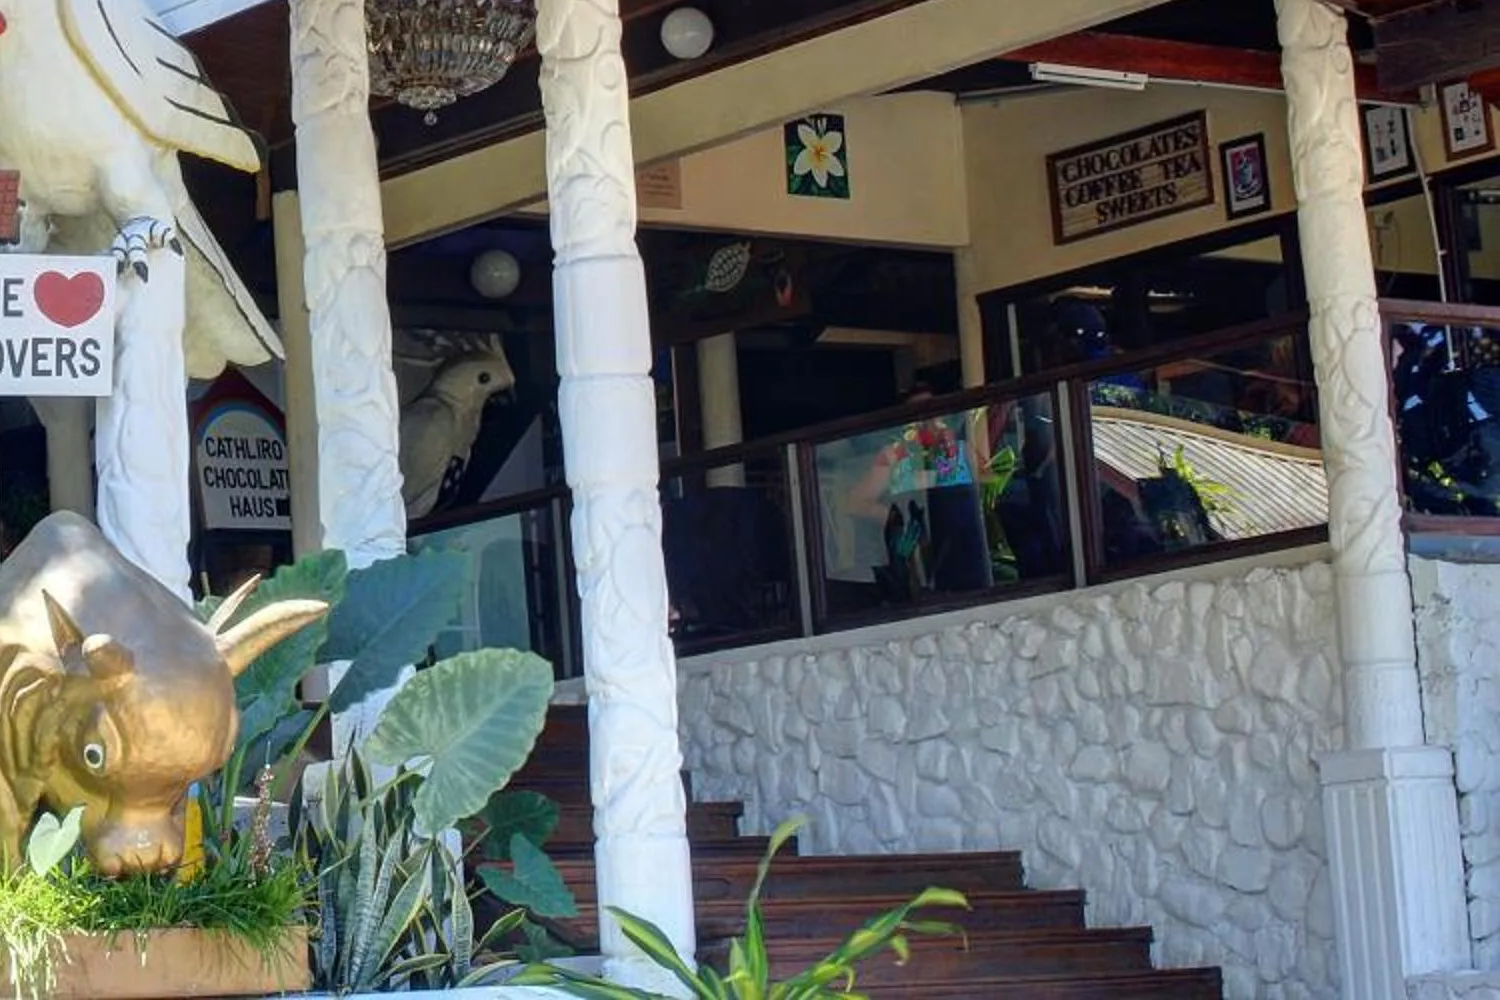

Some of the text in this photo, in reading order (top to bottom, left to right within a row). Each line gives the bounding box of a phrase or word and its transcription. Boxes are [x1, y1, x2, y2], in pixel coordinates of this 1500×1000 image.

[1061, 127, 1198, 184] CHOCOLATES
[1064, 153, 1201, 208] COFFEE TEA
[1095, 182, 1178, 224] SWEETS
